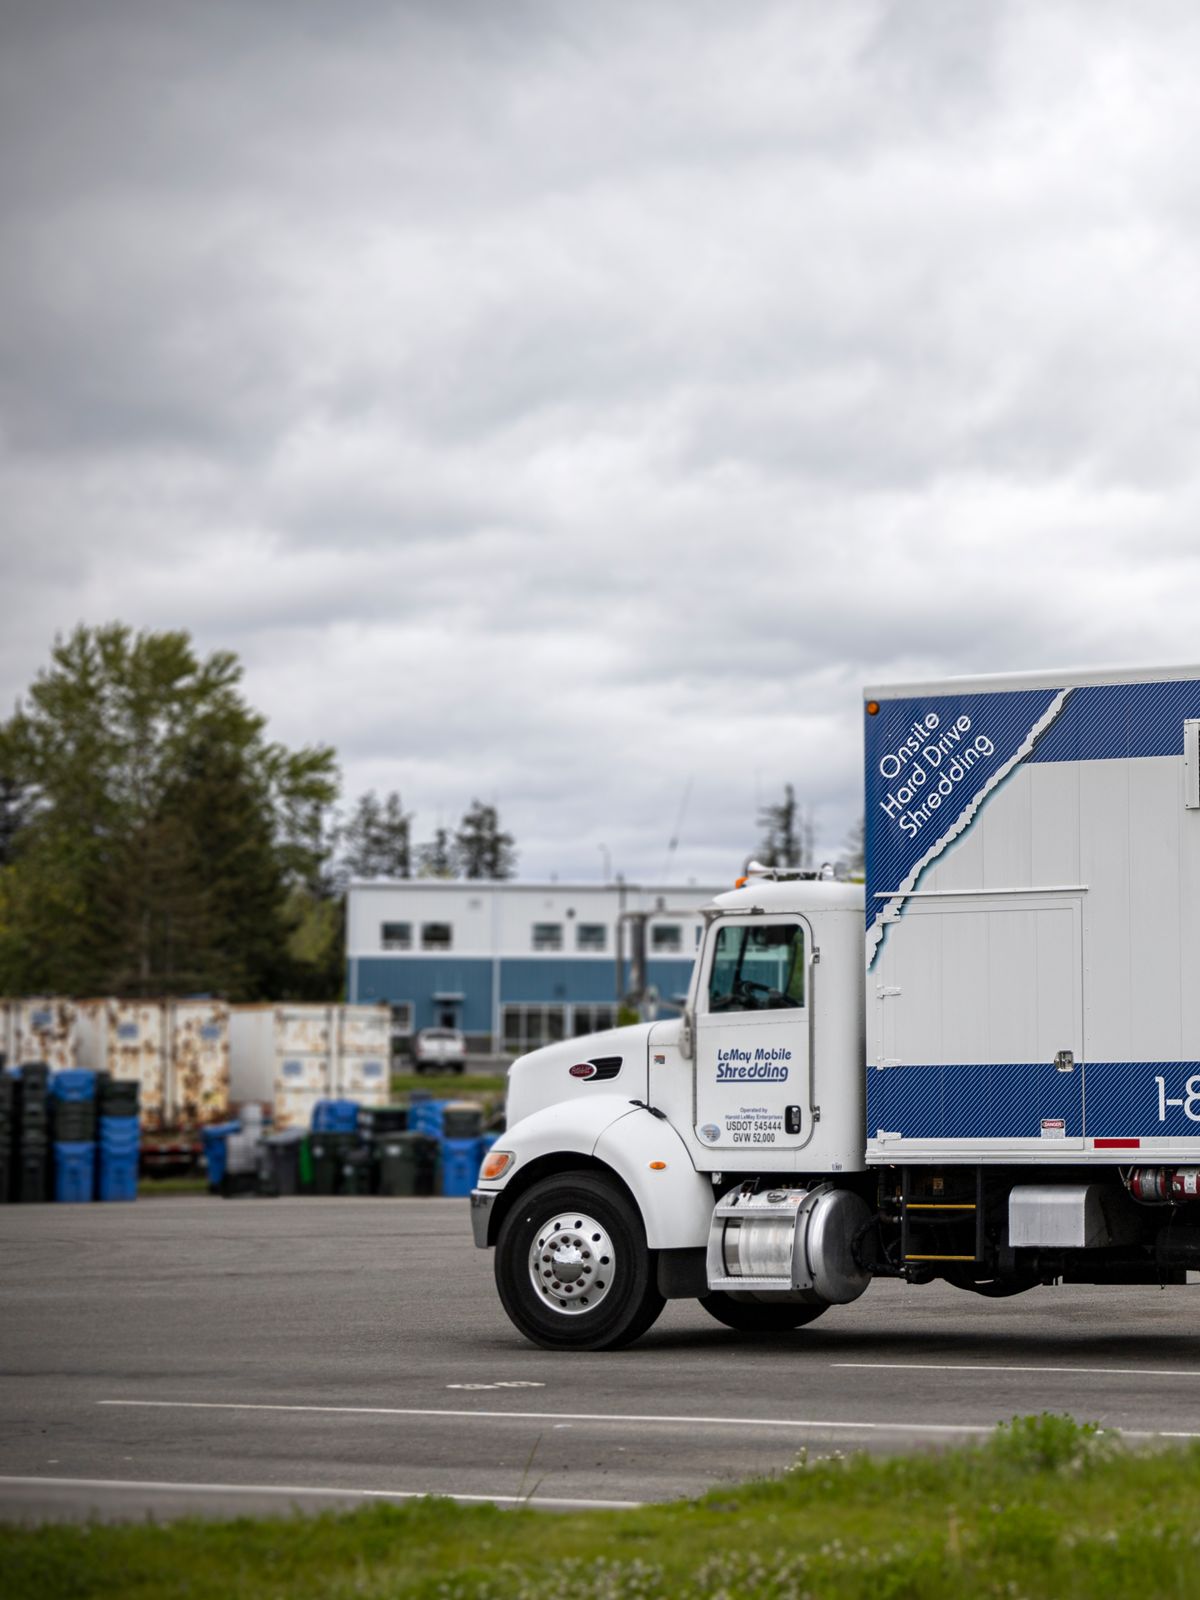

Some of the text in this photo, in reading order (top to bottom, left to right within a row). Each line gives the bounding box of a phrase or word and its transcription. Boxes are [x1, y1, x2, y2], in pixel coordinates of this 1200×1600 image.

[880, 713, 940, 779] Onsite
[880, 715, 971, 818] Hard Drive
[899, 735, 994, 838] Shredding
[718, 1048, 792, 1063] LeMay Mobile
[716, 1062, 789, 1082] Shredding
[726, 1121, 782, 1131] USDOT 545444
[733, 1132, 751, 1142] GVW
[752, 1132, 776, 1143] 52,000
